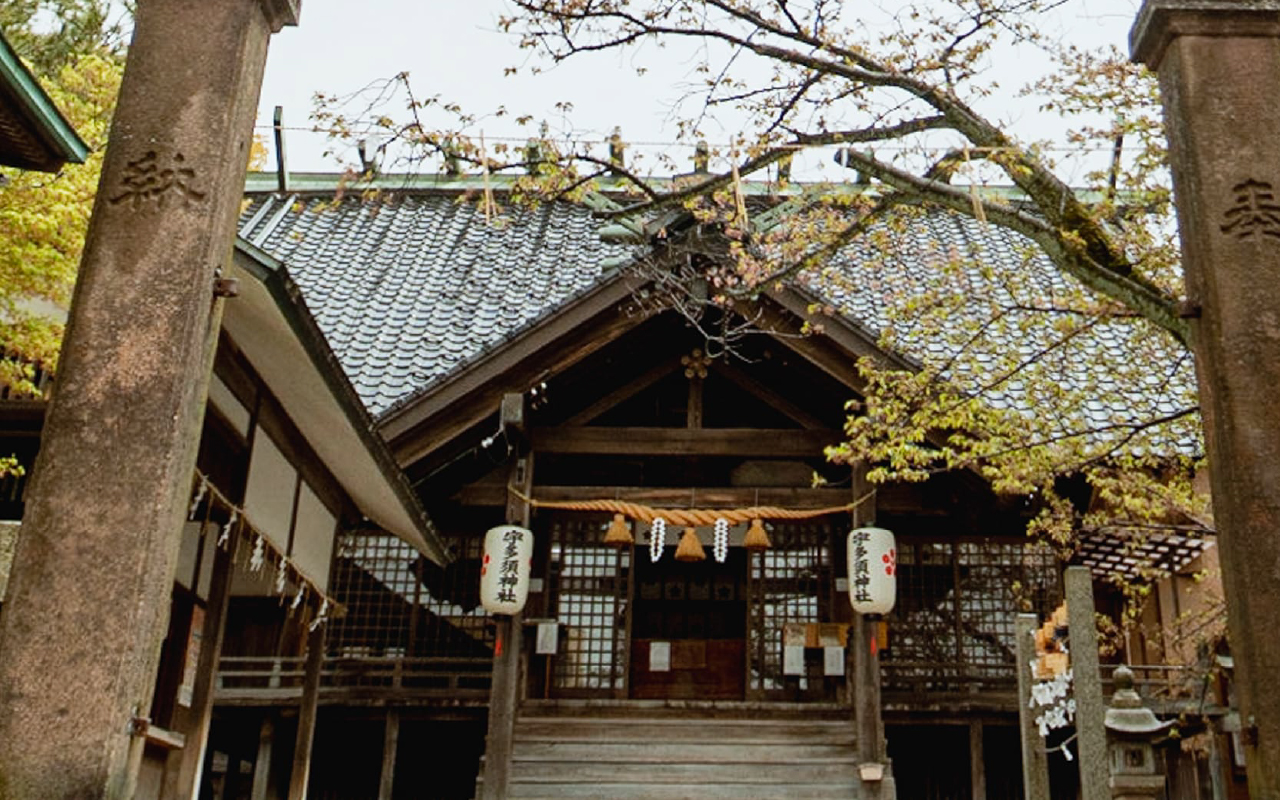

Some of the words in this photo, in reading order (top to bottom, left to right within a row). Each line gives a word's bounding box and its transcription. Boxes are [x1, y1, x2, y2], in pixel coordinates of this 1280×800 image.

[109, 150, 206, 212] 納
[495, 530, 524, 603] 宇多須神社
[852, 532, 874, 602] 宇多須神社
